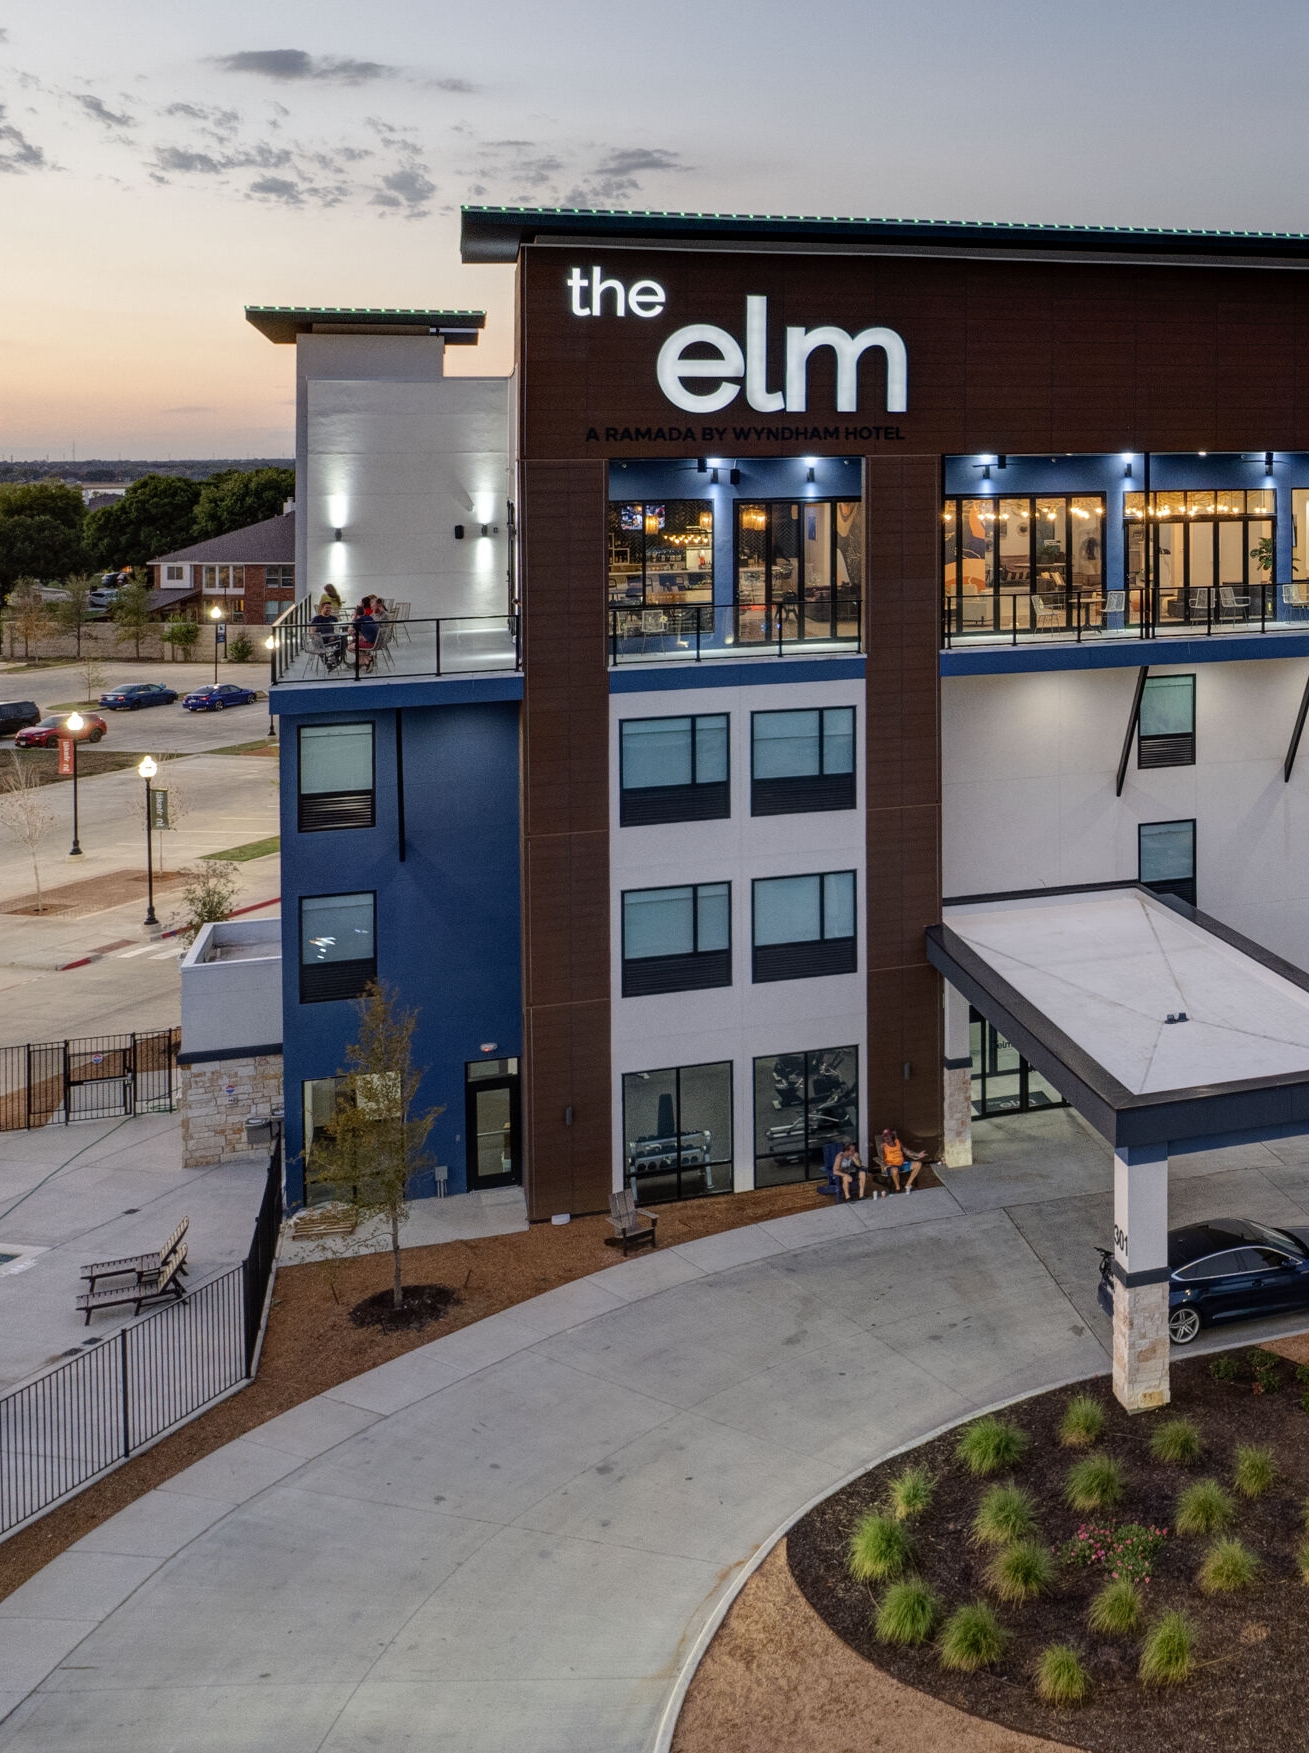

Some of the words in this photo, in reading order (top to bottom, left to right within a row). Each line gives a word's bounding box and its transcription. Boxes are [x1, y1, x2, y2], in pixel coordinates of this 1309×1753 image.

[567, 266, 666, 318] the
[657, 295, 907, 414] elm
[585, 427, 600, 442] A
[605, 426, 697, 442] RAMADA
[701, 426, 728, 441] BY
[732, 426, 840, 441] WYNDHAM
[845, 425, 906, 440] HOTEL
[1114, 1224, 1128, 1257] 301
